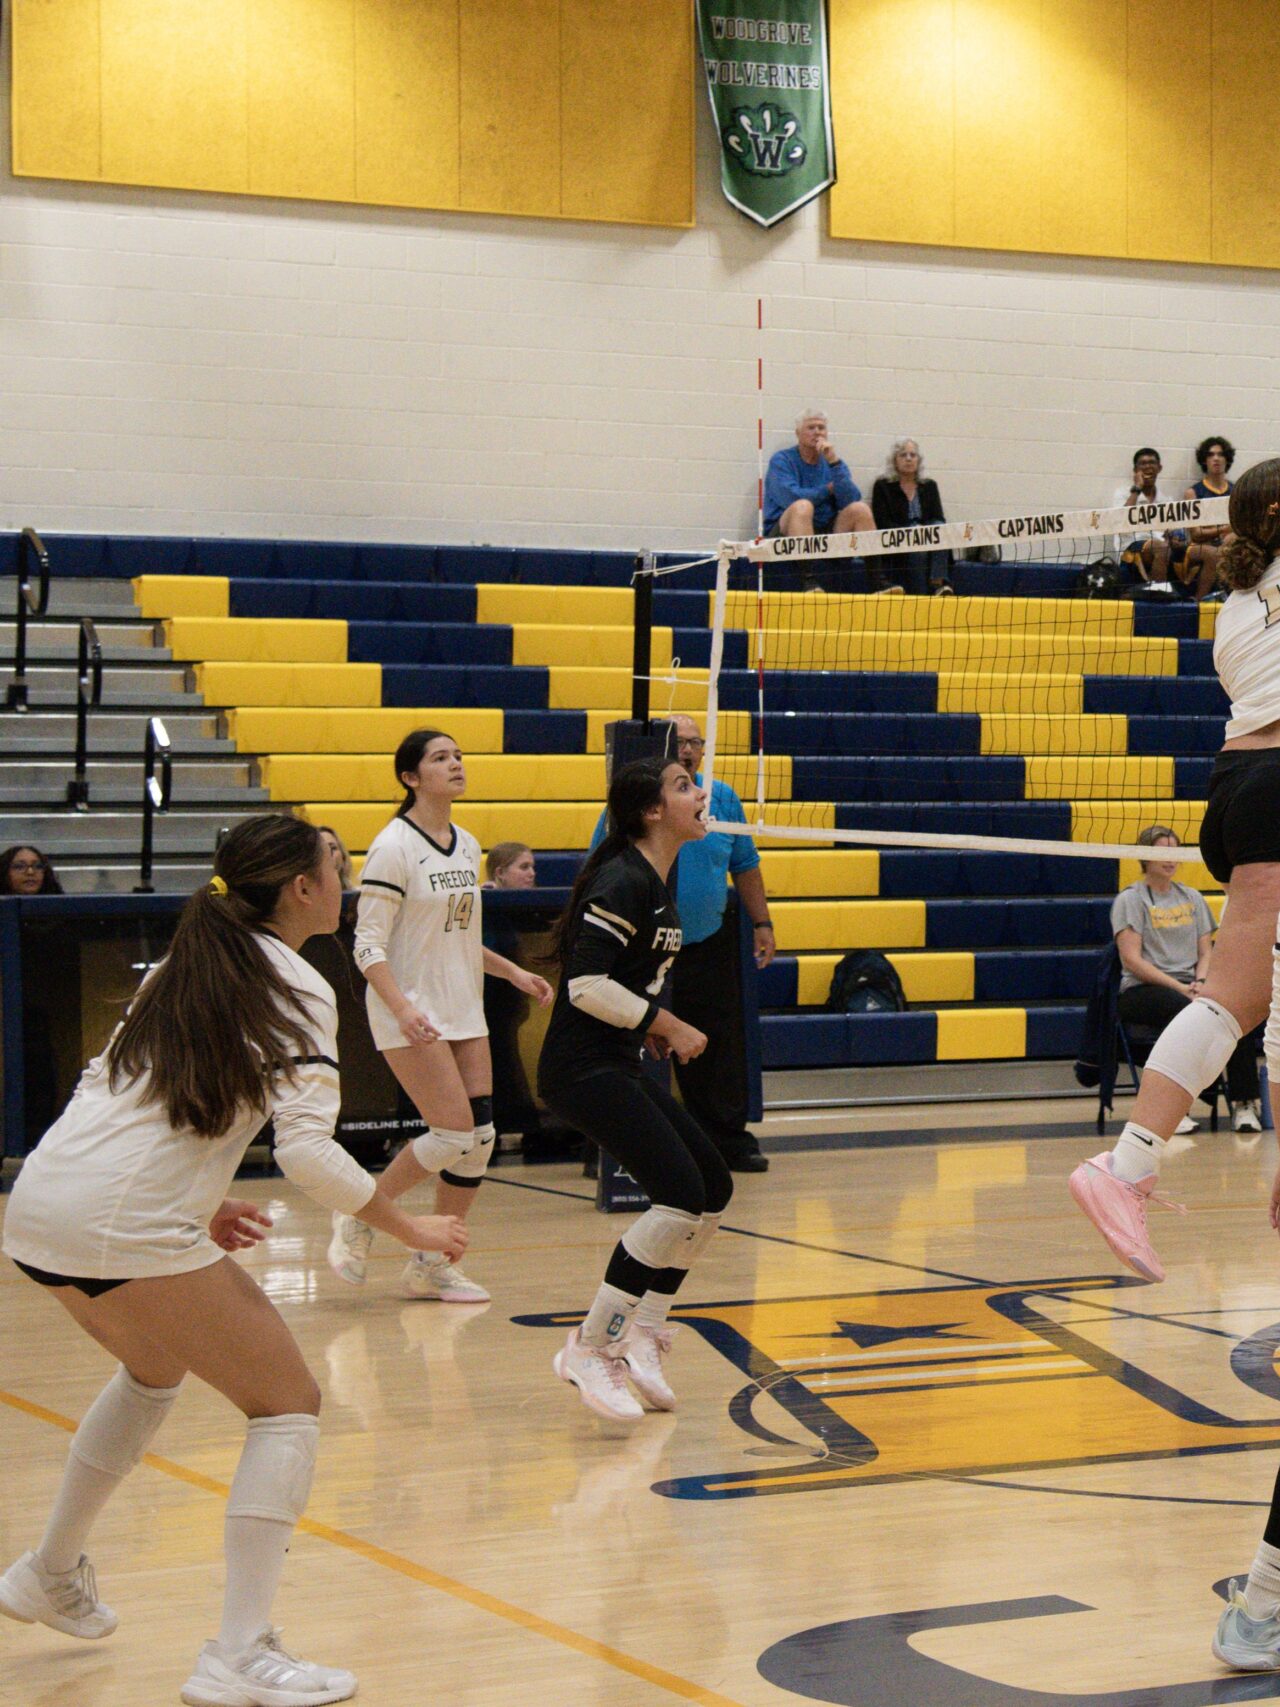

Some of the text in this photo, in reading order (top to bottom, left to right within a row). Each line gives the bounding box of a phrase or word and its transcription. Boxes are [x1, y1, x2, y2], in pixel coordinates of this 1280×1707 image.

[711, 16, 812, 45] WOODGROVE
[705, 59, 821, 90] WOLVERINES
[748, 132, 787, 171] W
[773, 535, 829, 556] CAPTAINS
[881, 526, 940, 548] CAPTAINS
[999, 514, 1064, 538] CAPTAINS
[1128, 499, 1200, 526] CAPTAINS
[444, 892, 474, 933] 14
